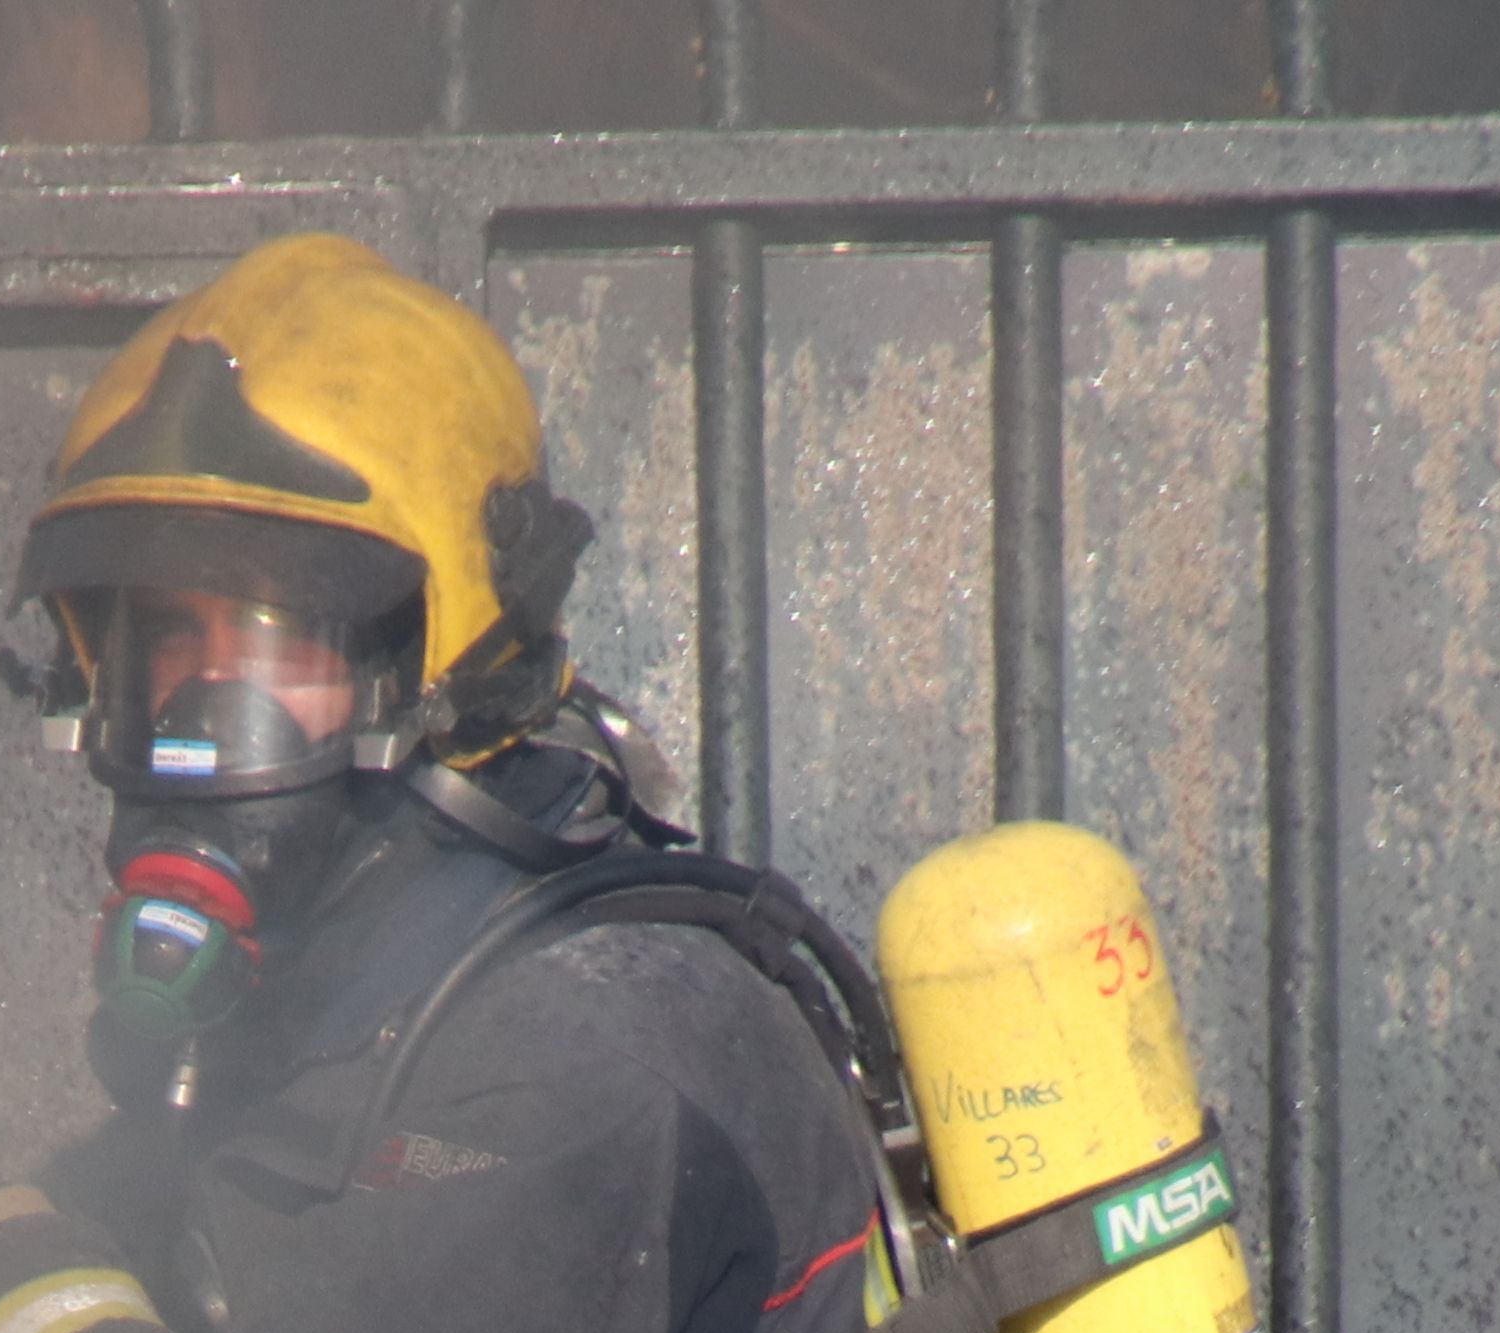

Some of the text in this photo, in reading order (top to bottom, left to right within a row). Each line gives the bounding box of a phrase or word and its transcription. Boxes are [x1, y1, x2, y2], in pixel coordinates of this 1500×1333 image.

[1083, 914, 1154, 997] 33
[985, 1133, 1047, 1180] 33
[1107, 1161, 1231, 1254] MSA
